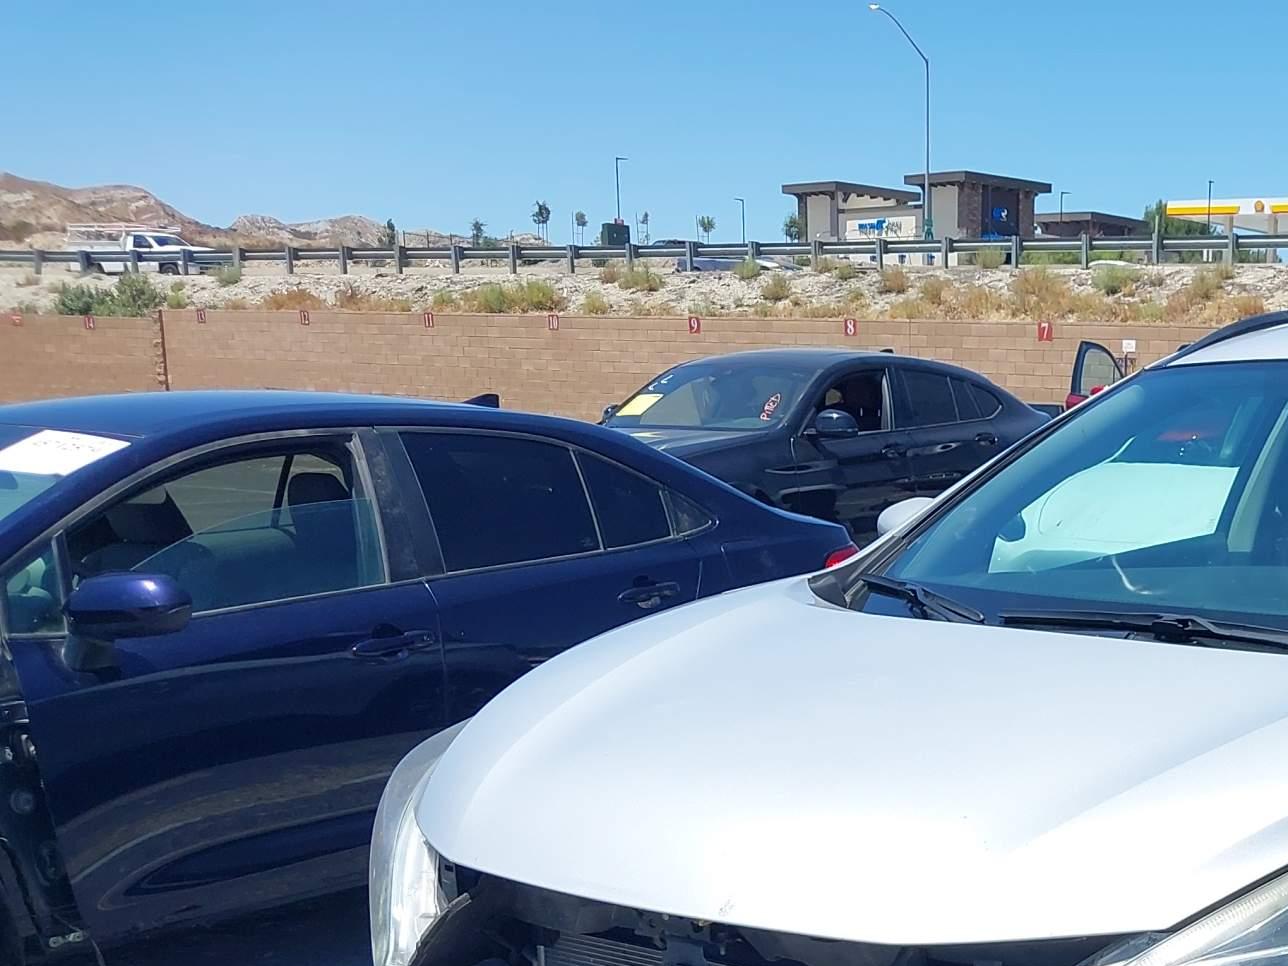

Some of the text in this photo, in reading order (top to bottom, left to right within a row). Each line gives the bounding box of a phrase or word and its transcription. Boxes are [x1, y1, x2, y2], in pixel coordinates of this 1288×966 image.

[300, 311, 309, 324] 12
[424, 313, 433, 327] 11
[549, 315, 558, 329] 10
[690, 317, 698, 332] 9
[846, 319, 855, 335] 8
[1040, 322, 1049, 339] 7
